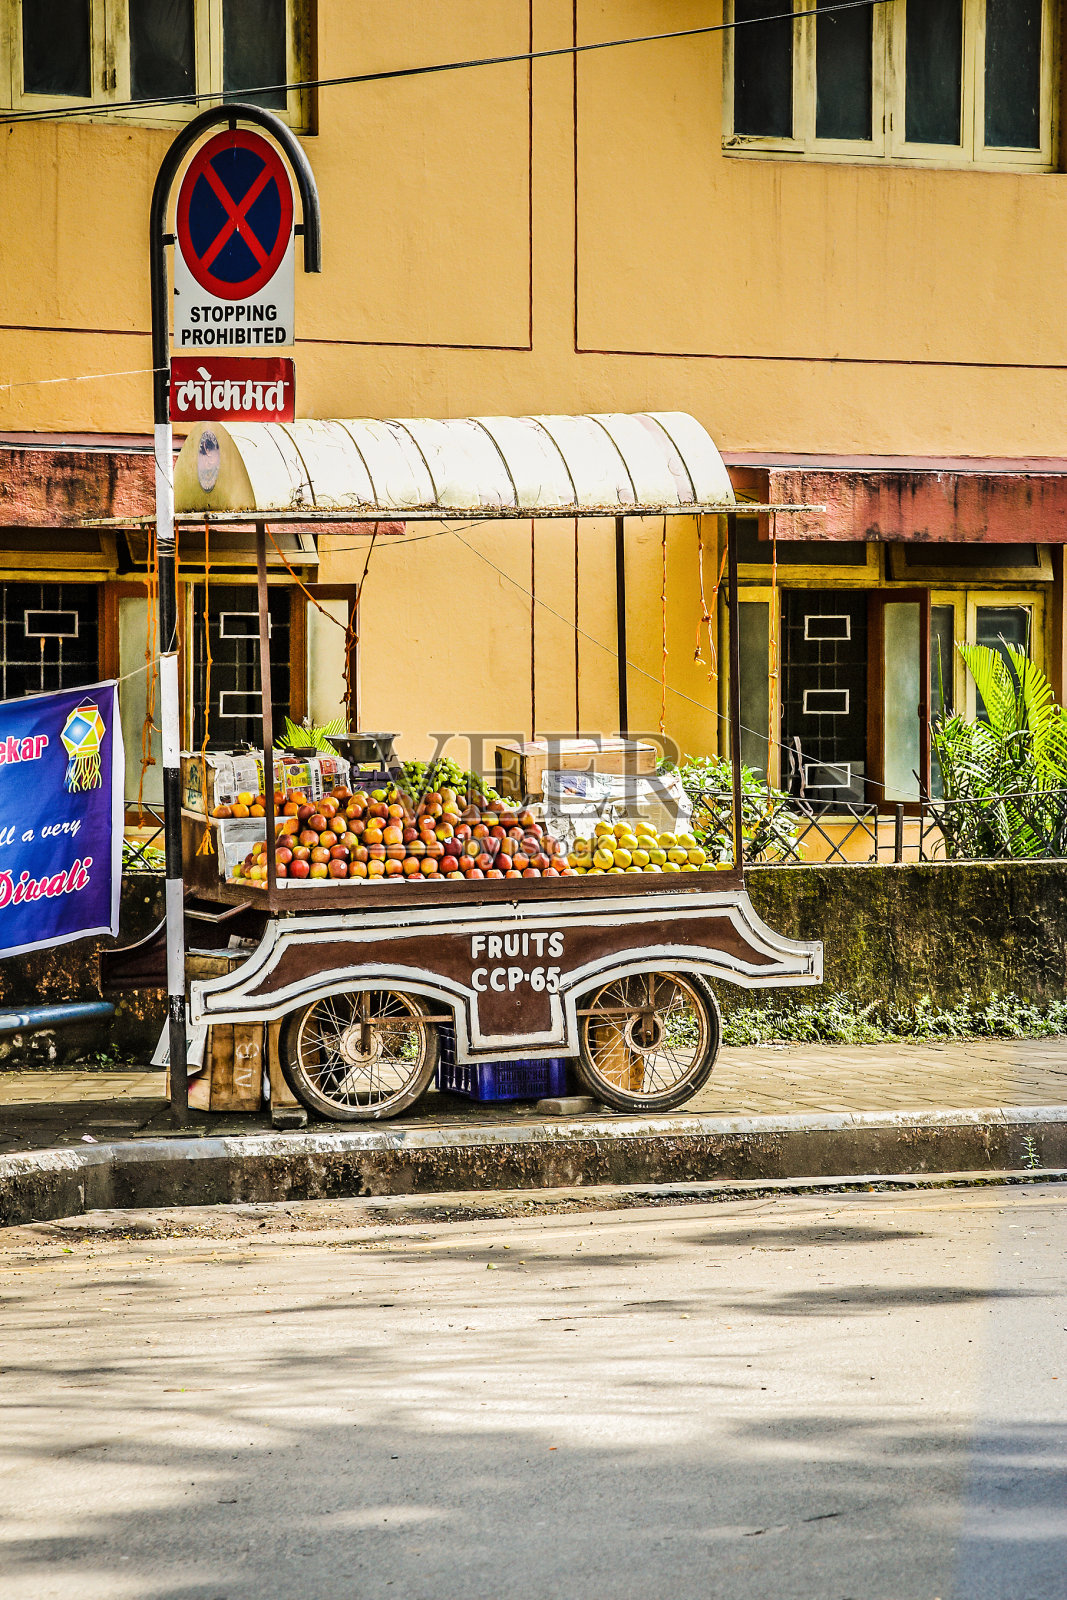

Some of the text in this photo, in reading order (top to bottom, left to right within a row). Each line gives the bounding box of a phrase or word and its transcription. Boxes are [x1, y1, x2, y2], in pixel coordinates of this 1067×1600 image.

[190, 304, 278, 323] STOPPING
[181, 326, 287, 346] PROHIBITED
[174, 366, 290, 412] लोकमत
[21, 828, 35, 842] a
[41, 819, 82, 838] very
[0, 856, 93, 910] Diwali
[471, 932, 565, 959] FRUITS
